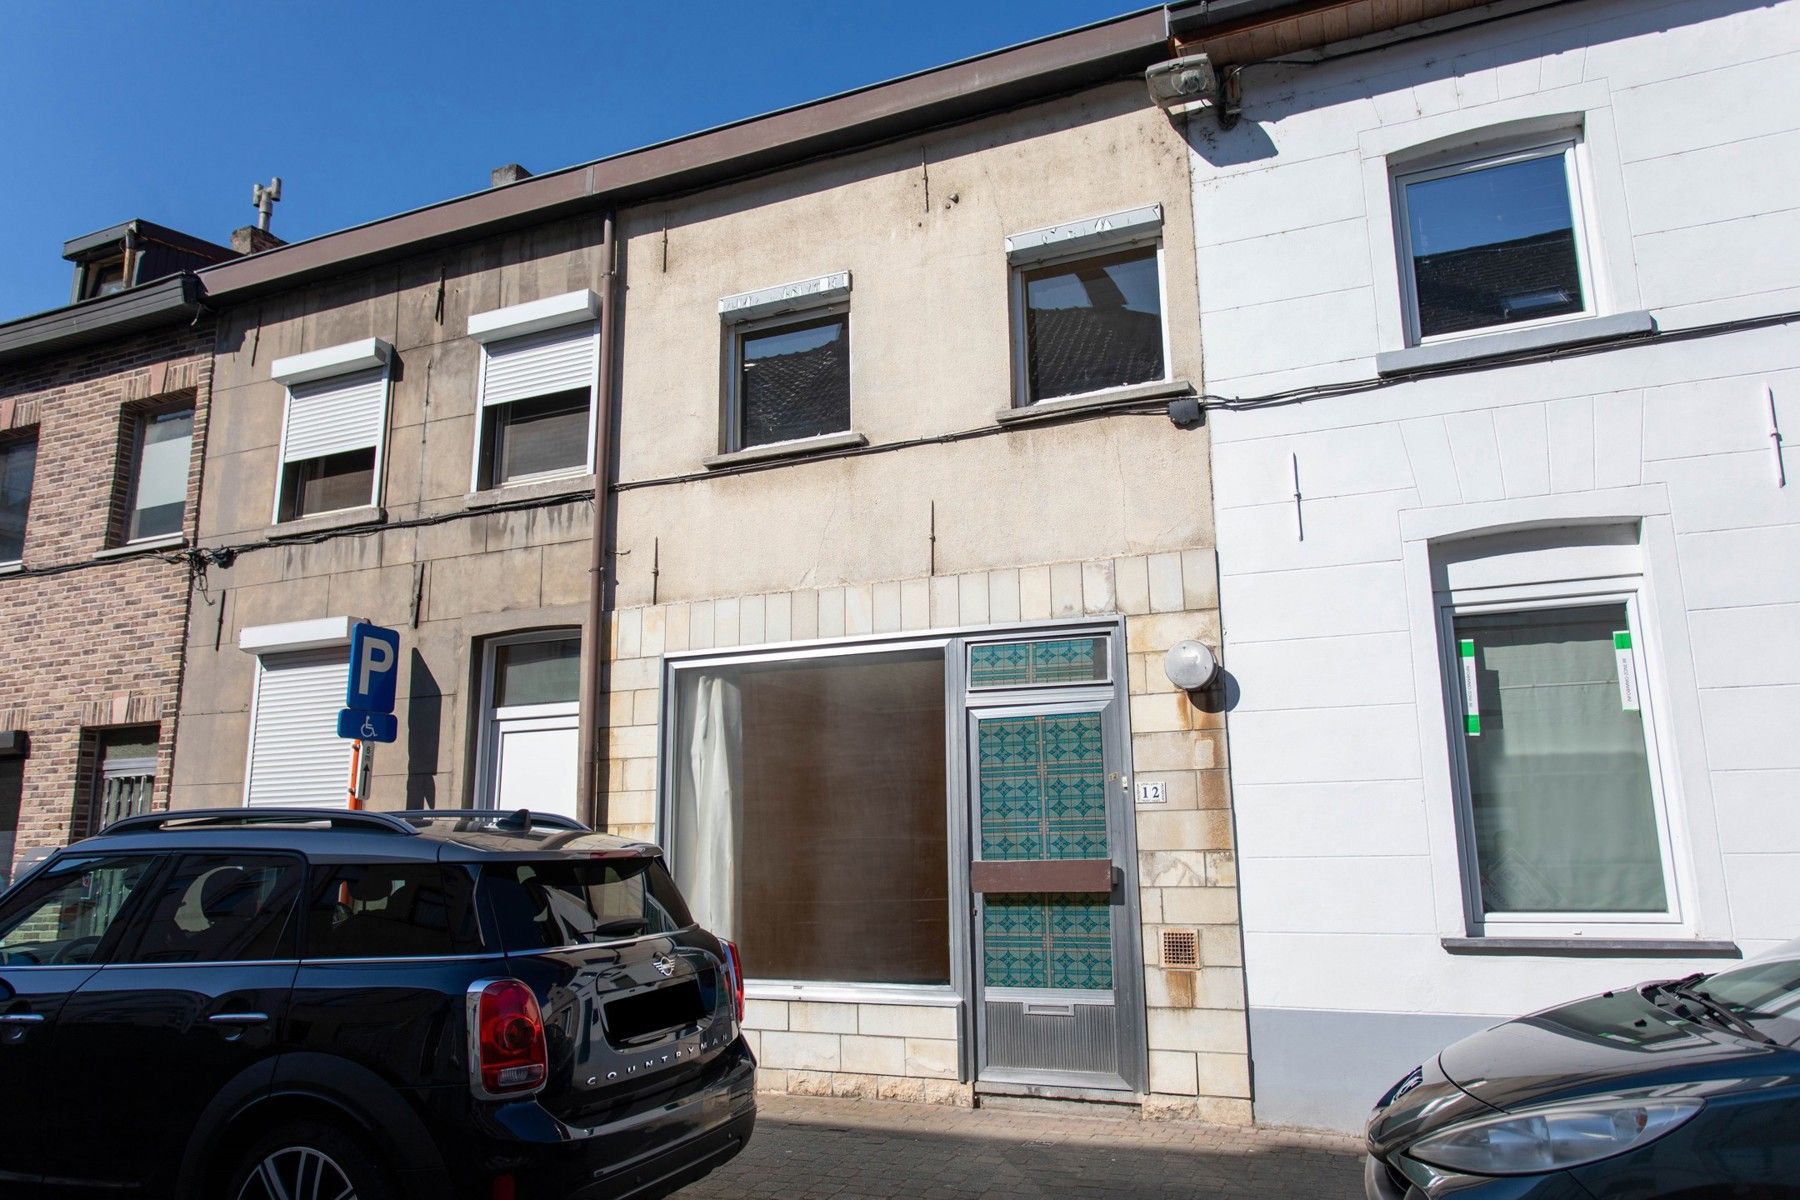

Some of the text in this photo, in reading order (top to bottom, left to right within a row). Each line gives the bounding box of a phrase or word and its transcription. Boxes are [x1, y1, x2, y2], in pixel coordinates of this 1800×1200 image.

[359, 636, 394, 695] P
[1142, 786, 1160, 798] 12
[587, 1035, 728, 1086] COUNTRYMAN
